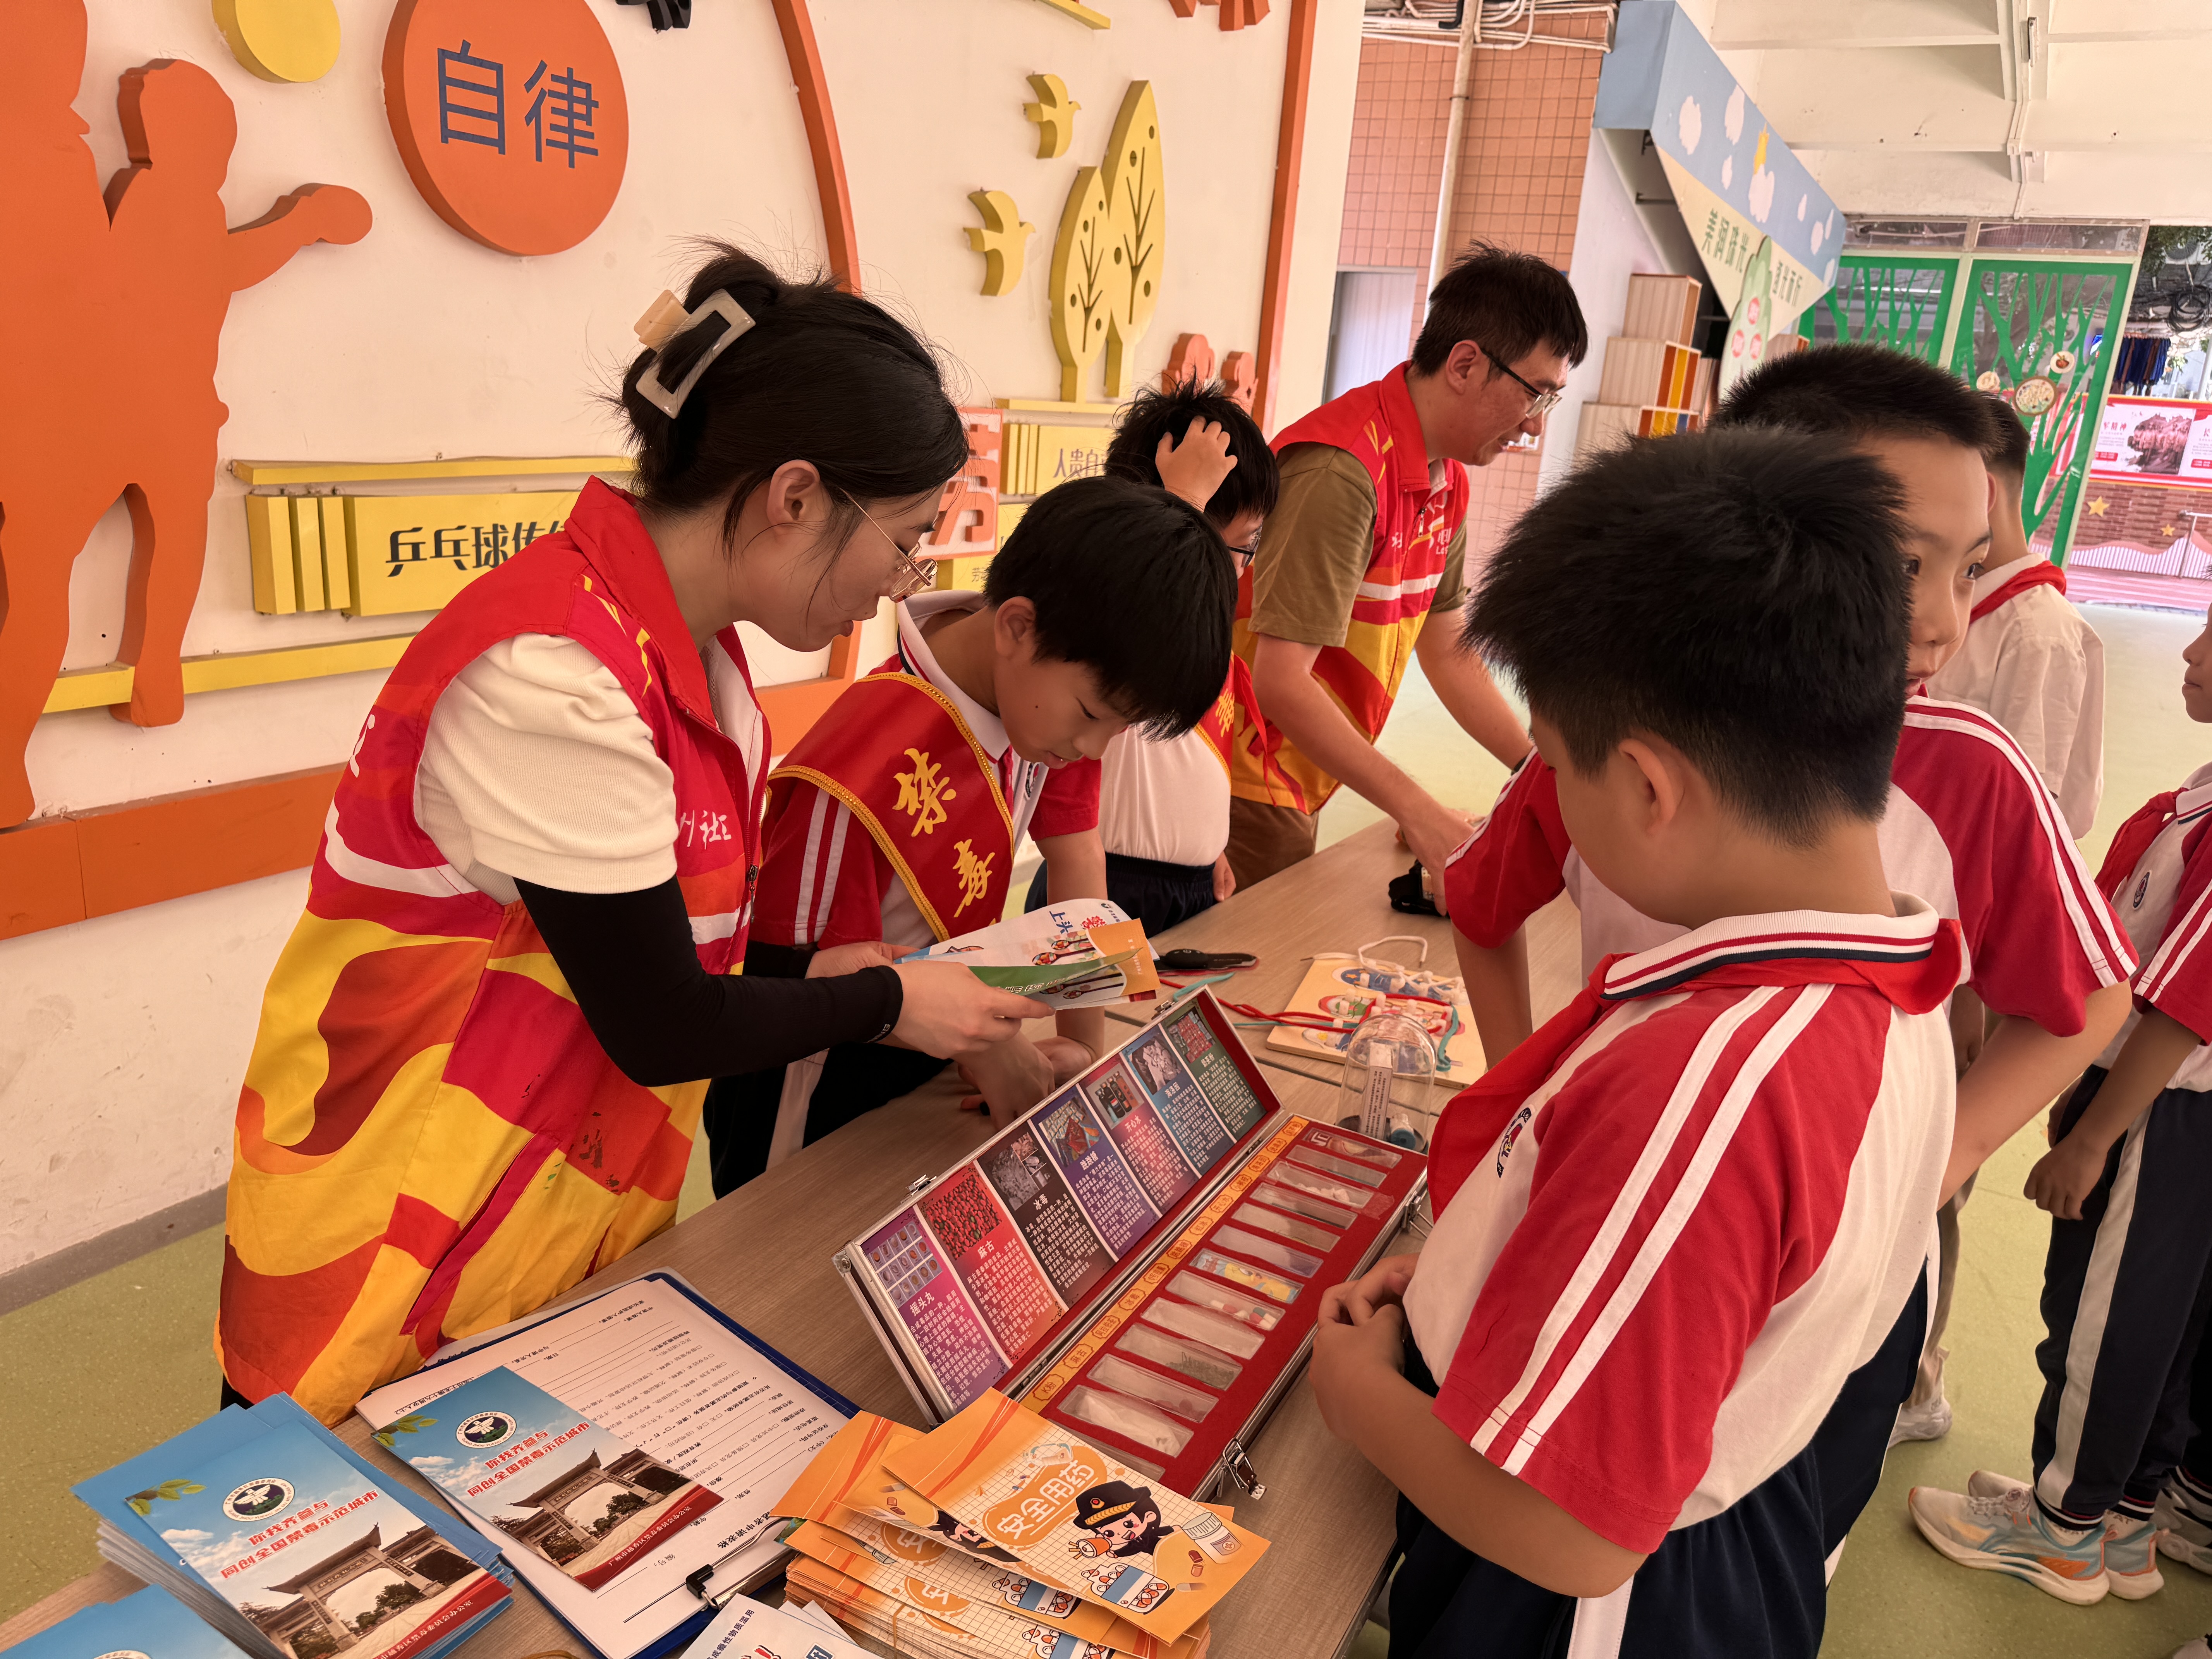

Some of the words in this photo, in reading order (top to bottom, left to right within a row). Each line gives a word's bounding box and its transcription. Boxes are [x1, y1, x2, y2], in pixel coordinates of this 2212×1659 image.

[438, 40, 599, 168] 自律
[1053, 448, 1106, 477] 人贵自
[1049, 911, 1073, 934] 上头
[1124, 1114, 1142, 1133] 开心水
[1032, 1192, 1049, 1211] 冰毒
[976, 1238, 996, 1260] 麻古
[908, 1289, 935, 1316] 摇头丸
[1124, 1293, 1140, 1306] 冰毒
[1070, 1349, 1087, 1364] 麻古
[1041, 1381, 1056, 1393] K粉
[466, 1421, 592, 1498] 同创全国禁毒示范城市
[484, 1429, 550, 1470] 你我齐参与
[996, 1458, 1096, 1540] 安全用药
[220, 1489, 379, 1579] 同创全国禁毒示范城市
[247, 1499, 329, 1547] 你我齐参与
[717, 1508, 773, 1548] 愿者申请表格
[375, 1600, 473, 1659] 市越秀区禁毒委员会办公室
